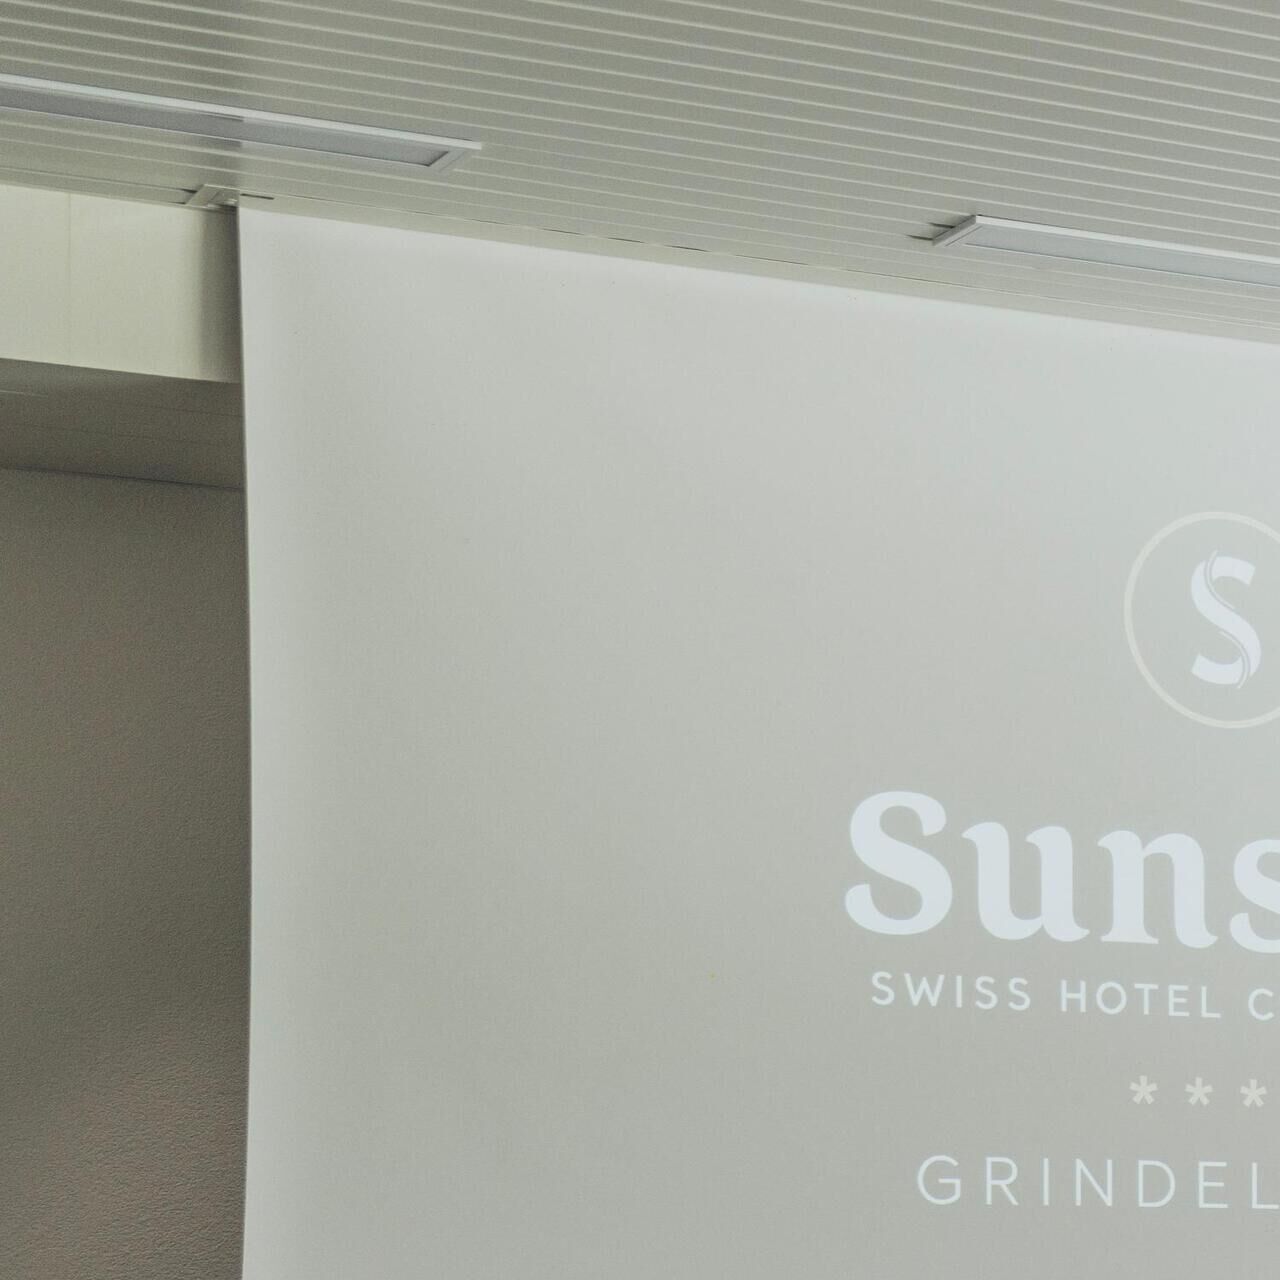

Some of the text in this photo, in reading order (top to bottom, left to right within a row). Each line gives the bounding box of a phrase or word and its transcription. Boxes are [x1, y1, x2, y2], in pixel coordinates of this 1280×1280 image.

[1190, 550, 1262, 689] S
[870, 970, 1032, 1012] SWISS
[1060, 979, 1223, 1020] HOTEL
